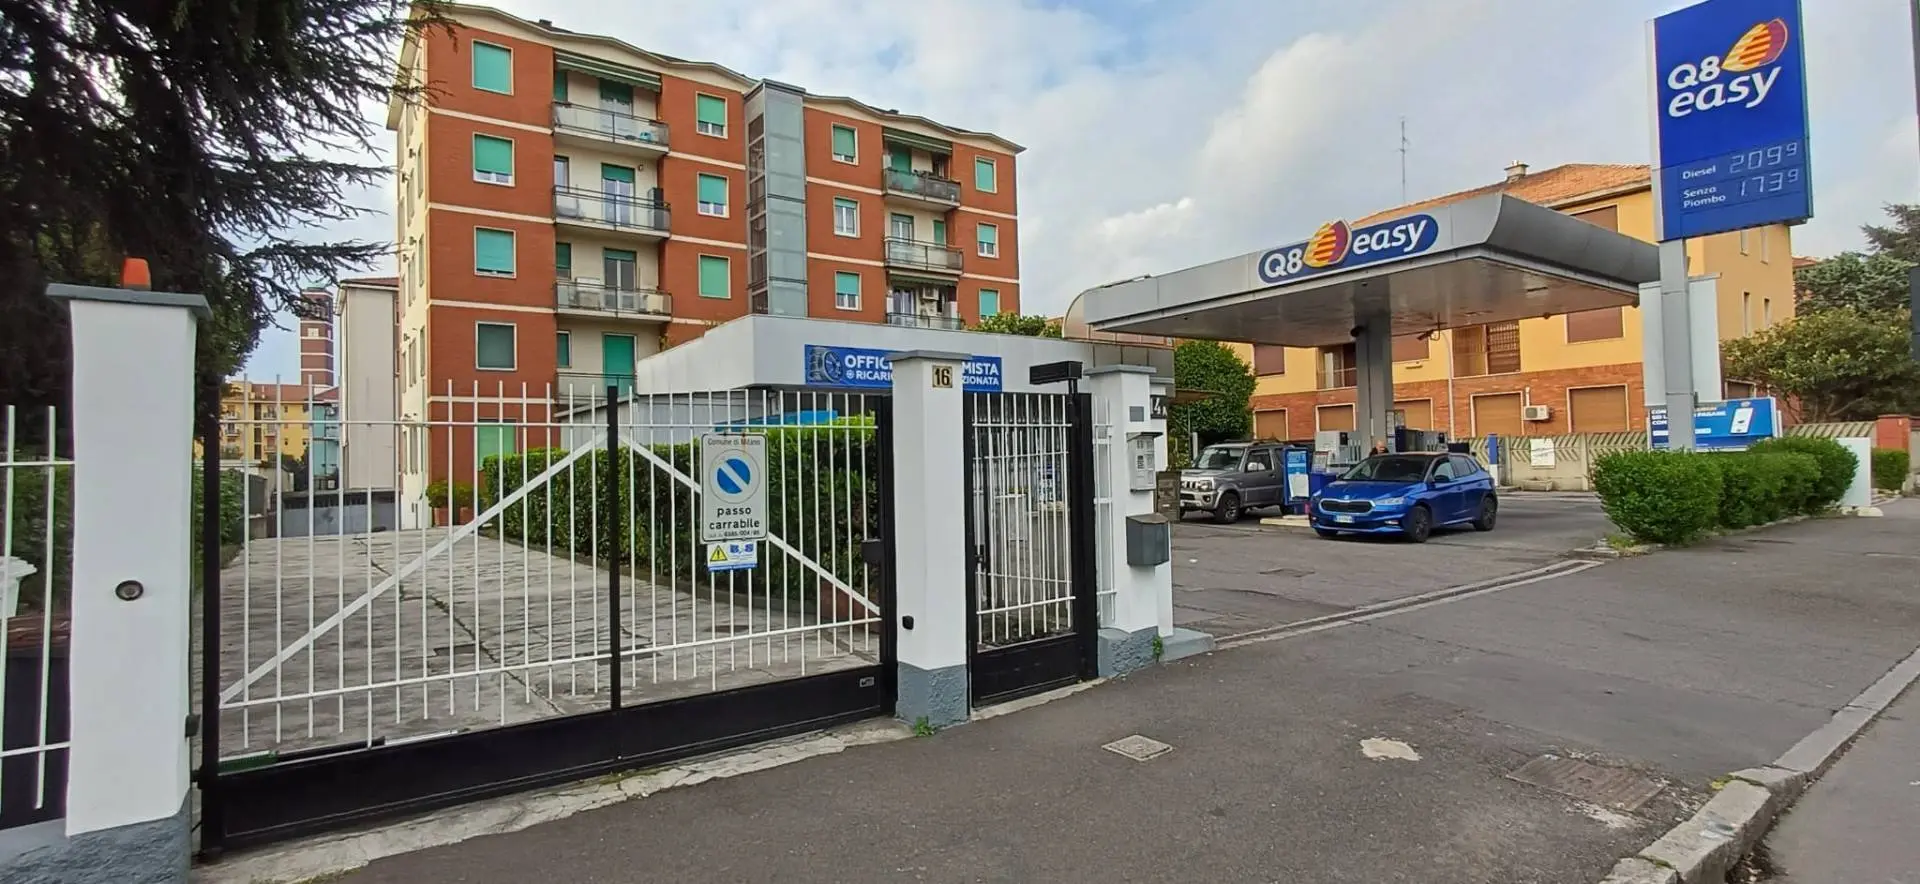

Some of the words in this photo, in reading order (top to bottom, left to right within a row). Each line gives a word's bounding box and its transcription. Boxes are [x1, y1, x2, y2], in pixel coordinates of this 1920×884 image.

[1667, 55, 1721, 90] Q8
[1668, 66, 1782, 117] easy
[1682, 164, 1717, 180] Diesel
[1683, 185, 1717, 199] Senza
[1683, 194, 1727, 209] Piombo
[1264, 249, 1303, 278] Q8
[1352, 219, 1428, 255] easy
[844, 353, 893, 371] OFFIC
[961, 361, 1000, 376] MISTA
[855, 370, 894, 381] RICARI
[961, 375, 1000, 386] ZIONATA
[935, 367, 951, 386] 16
[717, 507, 752, 518] passo
[709, 518, 760, 530] carrabile
